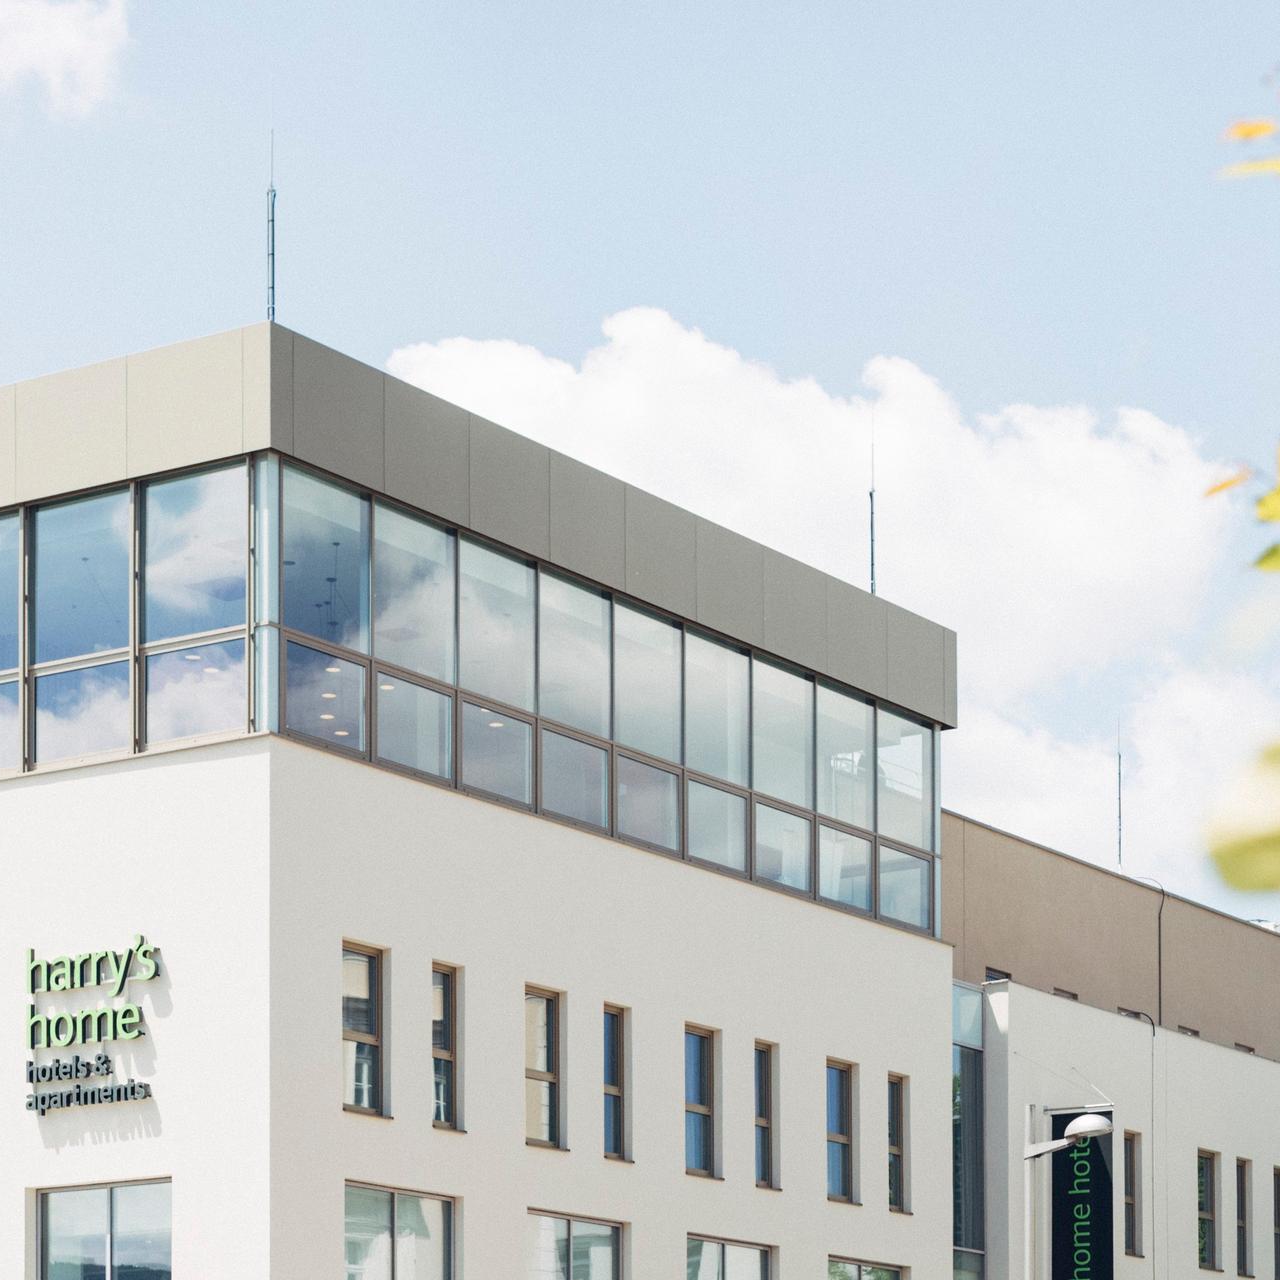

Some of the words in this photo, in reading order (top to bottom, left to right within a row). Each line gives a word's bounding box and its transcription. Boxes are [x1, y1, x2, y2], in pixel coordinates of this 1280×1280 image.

[25, 933, 161, 997] harry's
[25, 1001, 146, 1050] home
[25, 1055, 91, 1083] hotels
[91, 1053, 114, 1076] &
[25, 1078, 153, 1116] apartments
[1068, 1135, 1091, 1195] hote
